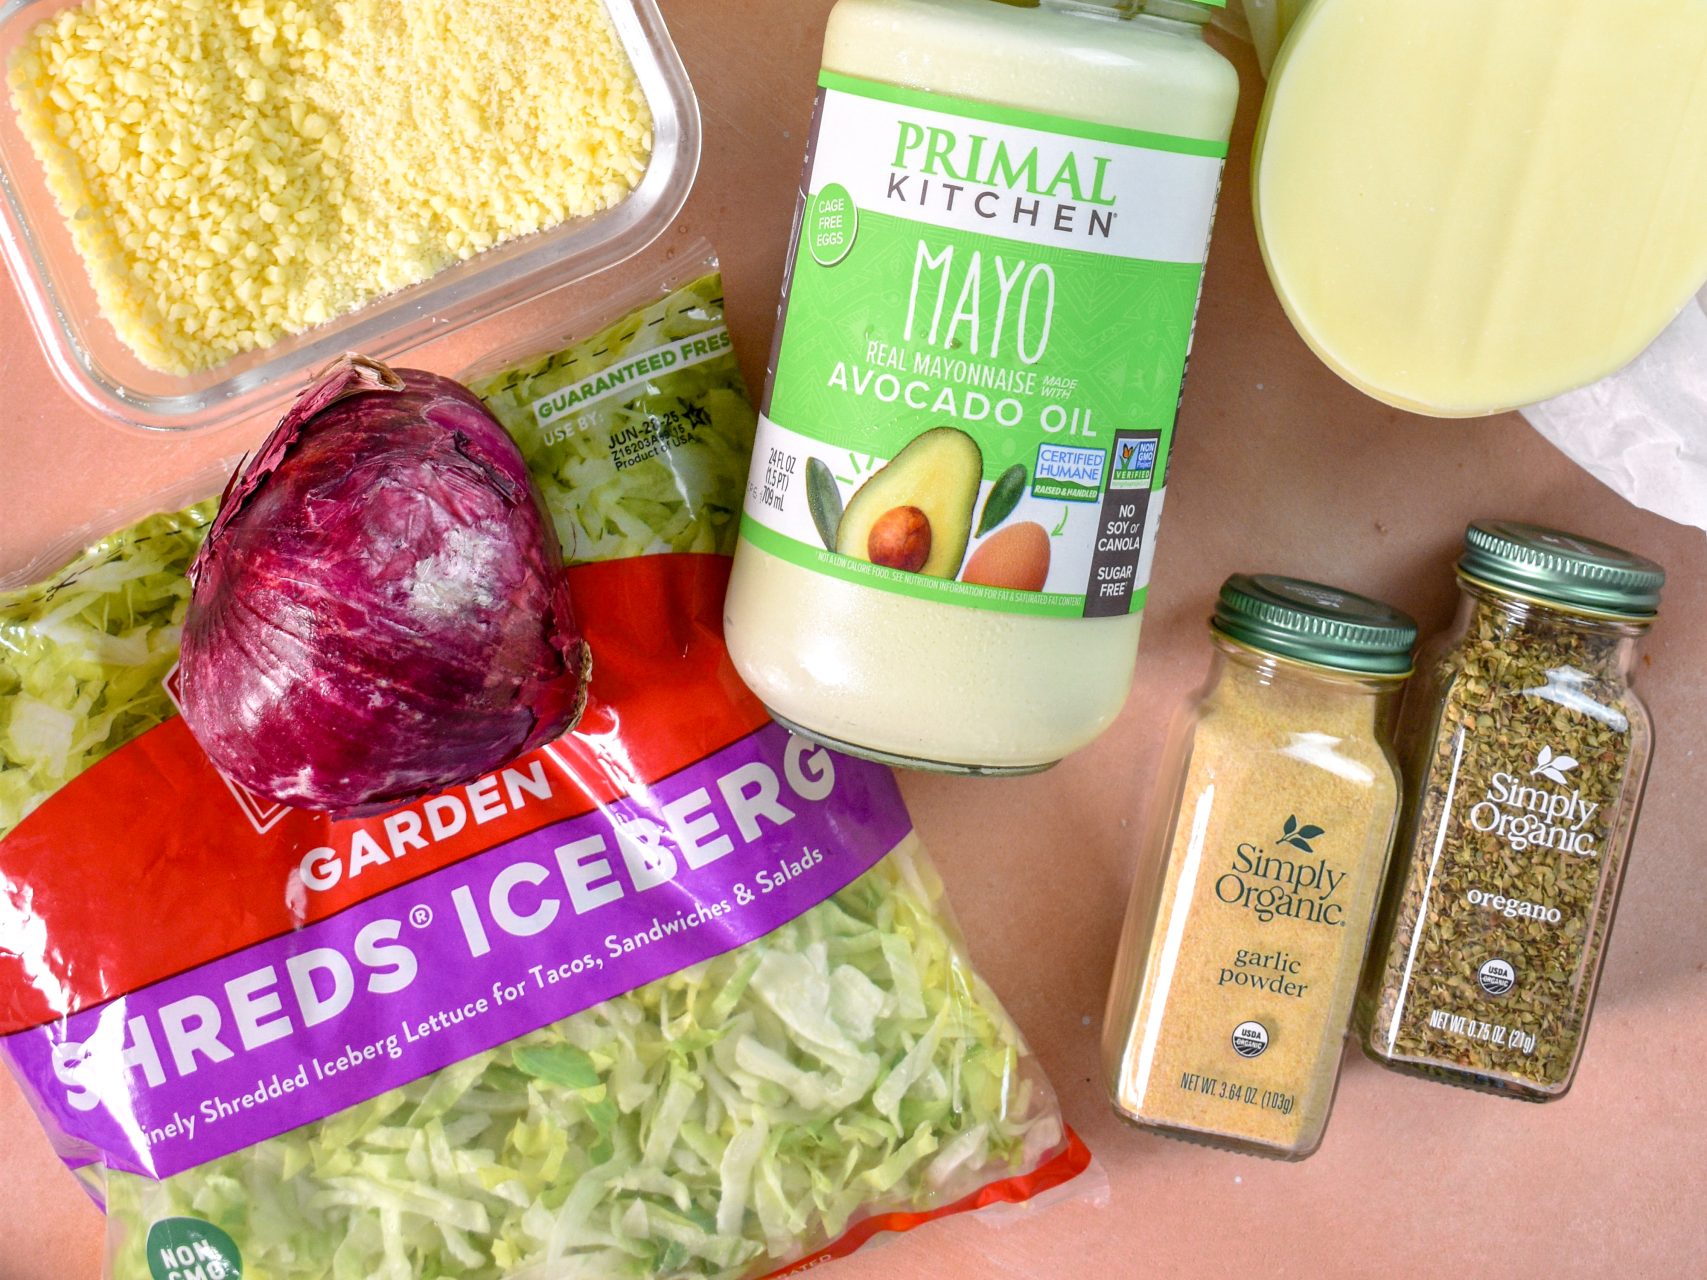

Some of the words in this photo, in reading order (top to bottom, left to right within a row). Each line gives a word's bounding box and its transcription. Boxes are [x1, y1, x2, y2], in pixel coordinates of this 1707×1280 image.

[891, 120, 1117, 206] PRIMAL
[819, 198, 844, 212] CAGE
[887, 173, 1112, 238] KITCHEN
[819, 217, 843, 229] FREE
[816, 233, 844, 246] EGGS
[903, 239, 1055, 365] MAYO
[538, 350, 677, 419] GUARANTEED
[683, 331, 731, 361] FRES
[866, 340, 906, 371] REAL
[913, 352, 1037, 395] MAYONNAISE
[1043, 376, 1078, 389] MADE
[827, 361, 1023, 426] AVOCADO
[1040, 405, 1097, 437] OIL
[1041, 386, 1072, 400] WITH
[543, 428, 575, 448] USE
[1140, 443, 1155, 452] NON
[615, 447, 659, 471] Product
[671, 433, 695, 447] USA
[1041, 449, 1102, 466] CERTIFIED
[1138, 452, 1153, 461] GMO
[786, 455, 796, 474] OZ
[1040, 464, 1099, 480] HUMANE
[1116, 470, 1150, 479] VERIFIED
[1034, 485, 1061, 495] RAISED
[1067, 489, 1098, 499] HANDLED
[1119, 504, 1135, 518] NO
[1107, 521, 1129, 535] SOY
[1130, 523, 1140, 534] or
[1098, 537, 1140, 551] CANOLA
[1097, 566, 1133, 580] SUGAR
[939, 580, 984, 597] INFORMATION
[1100, 582, 1125, 597] FREE
[1487, 773, 1600, 830] Simply
[299, 760, 552, 891] GARDEN
[1470, 802, 1594, 856] Organic
[1231, 843, 1347, 900] Simply
[1215, 874, 1343, 926] Organic
[1467, 890, 1561, 922] oregano
[52, 919, 418, 1111] SHREDS
[451, 732, 835, 958] ICEBERG
[1234, 949, 1301, 974] garlic
[1489, 966, 1507, 977] USDA
[1218, 967, 1308, 998] powder
[142, 1112, 195, 1146] inely
[200, 1064, 309, 1123] Shredded
[313, 1031, 403, 1081] Iceberg
[403, 1000, 490, 1043] Lettuce
[492, 978, 527, 1008] for
[529, 952, 605, 990] Tacos,
[604, 899, 732, 959] Sandwiches
[733, 883, 755, 904] &
[755, 847, 824, 894] Salads
[1242, 1029, 1261, 1040] USDA
[1429, 1010, 1448, 1028] NET
[1468, 1020, 1490, 1040] 0.75
[1508, 1029, 1536, 1053] (21g)
[1236, 1038, 1262, 1050] ORGANIC
[1181, 1073, 1199, 1091] NET
[1219, 1082, 1242, 1102] 3.64
[1261, 1090, 1294, 1115] (103g)
[160, 1239, 210, 1269] NON
